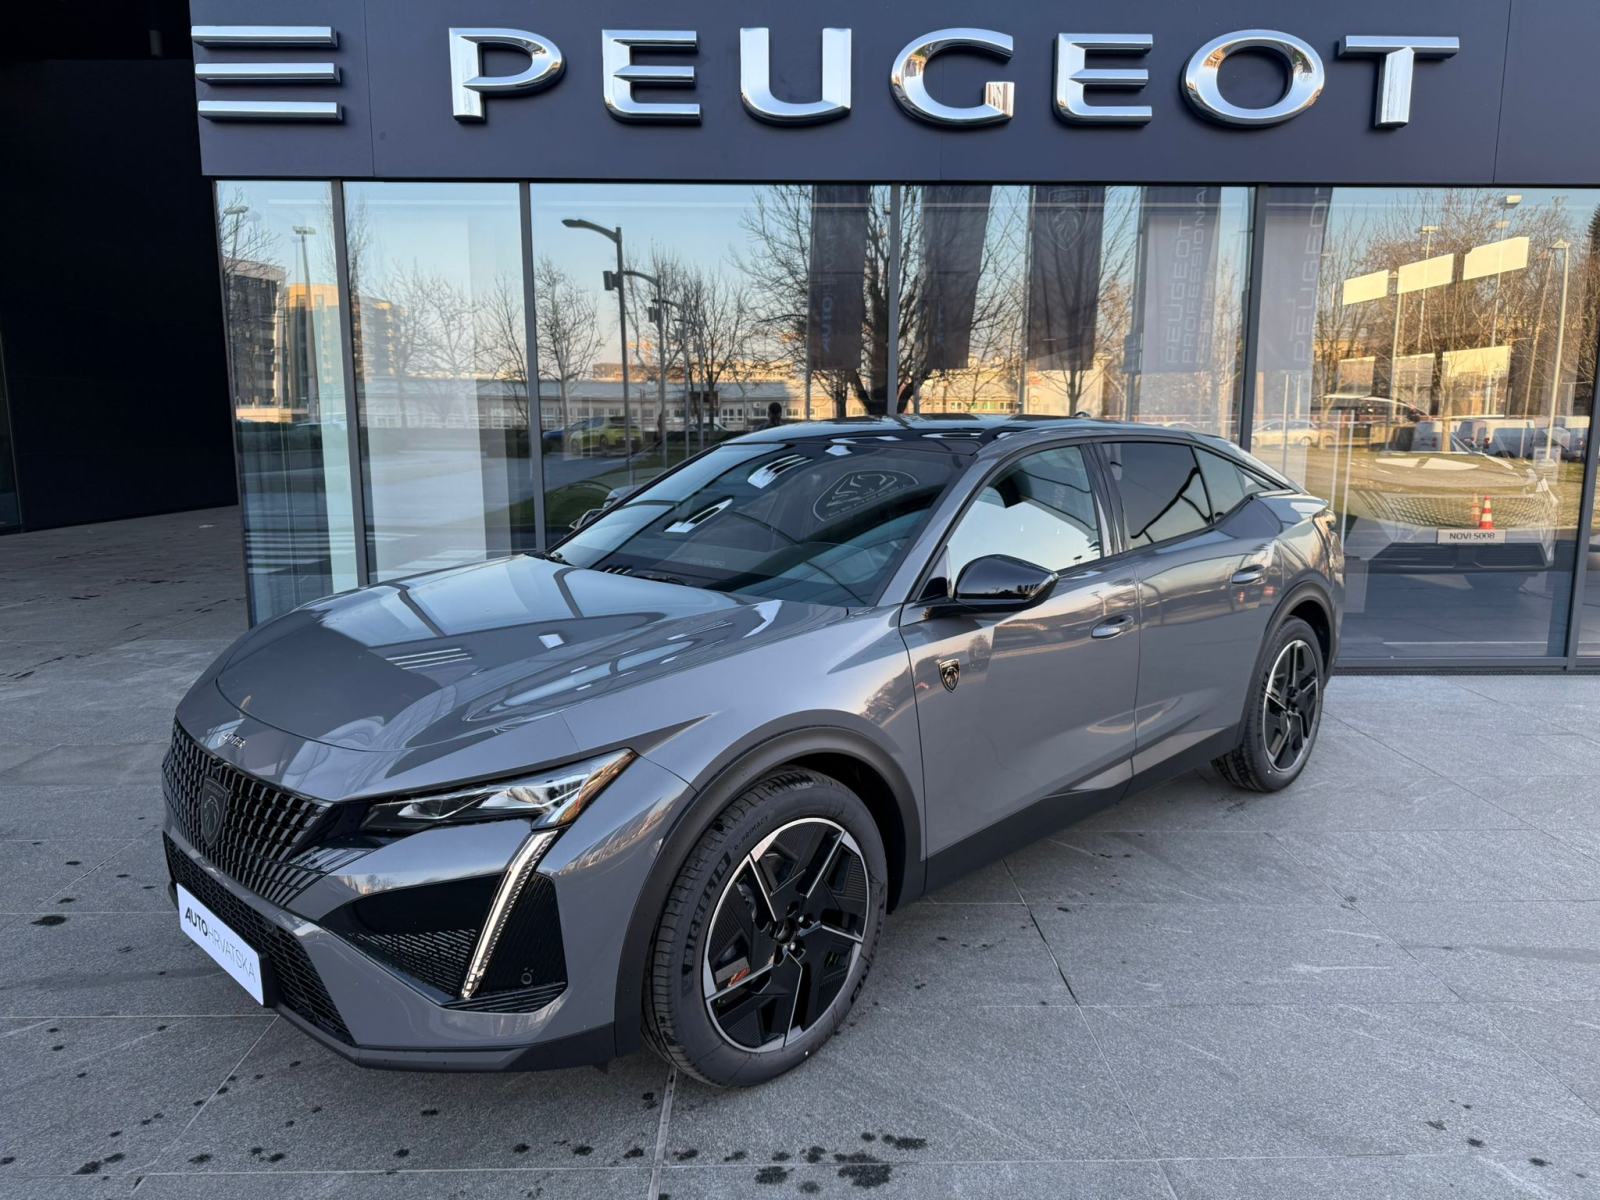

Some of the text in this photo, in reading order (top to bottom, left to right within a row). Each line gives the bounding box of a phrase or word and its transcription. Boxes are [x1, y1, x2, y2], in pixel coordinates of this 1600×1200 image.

[448, 26, 1460, 127] PEUGEOT
[1166, 218, 1193, 364] PEUGEOT
[1182, 187, 1208, 363] PROFESSIONA
[1449, 531, 1472, 541] NOVI
